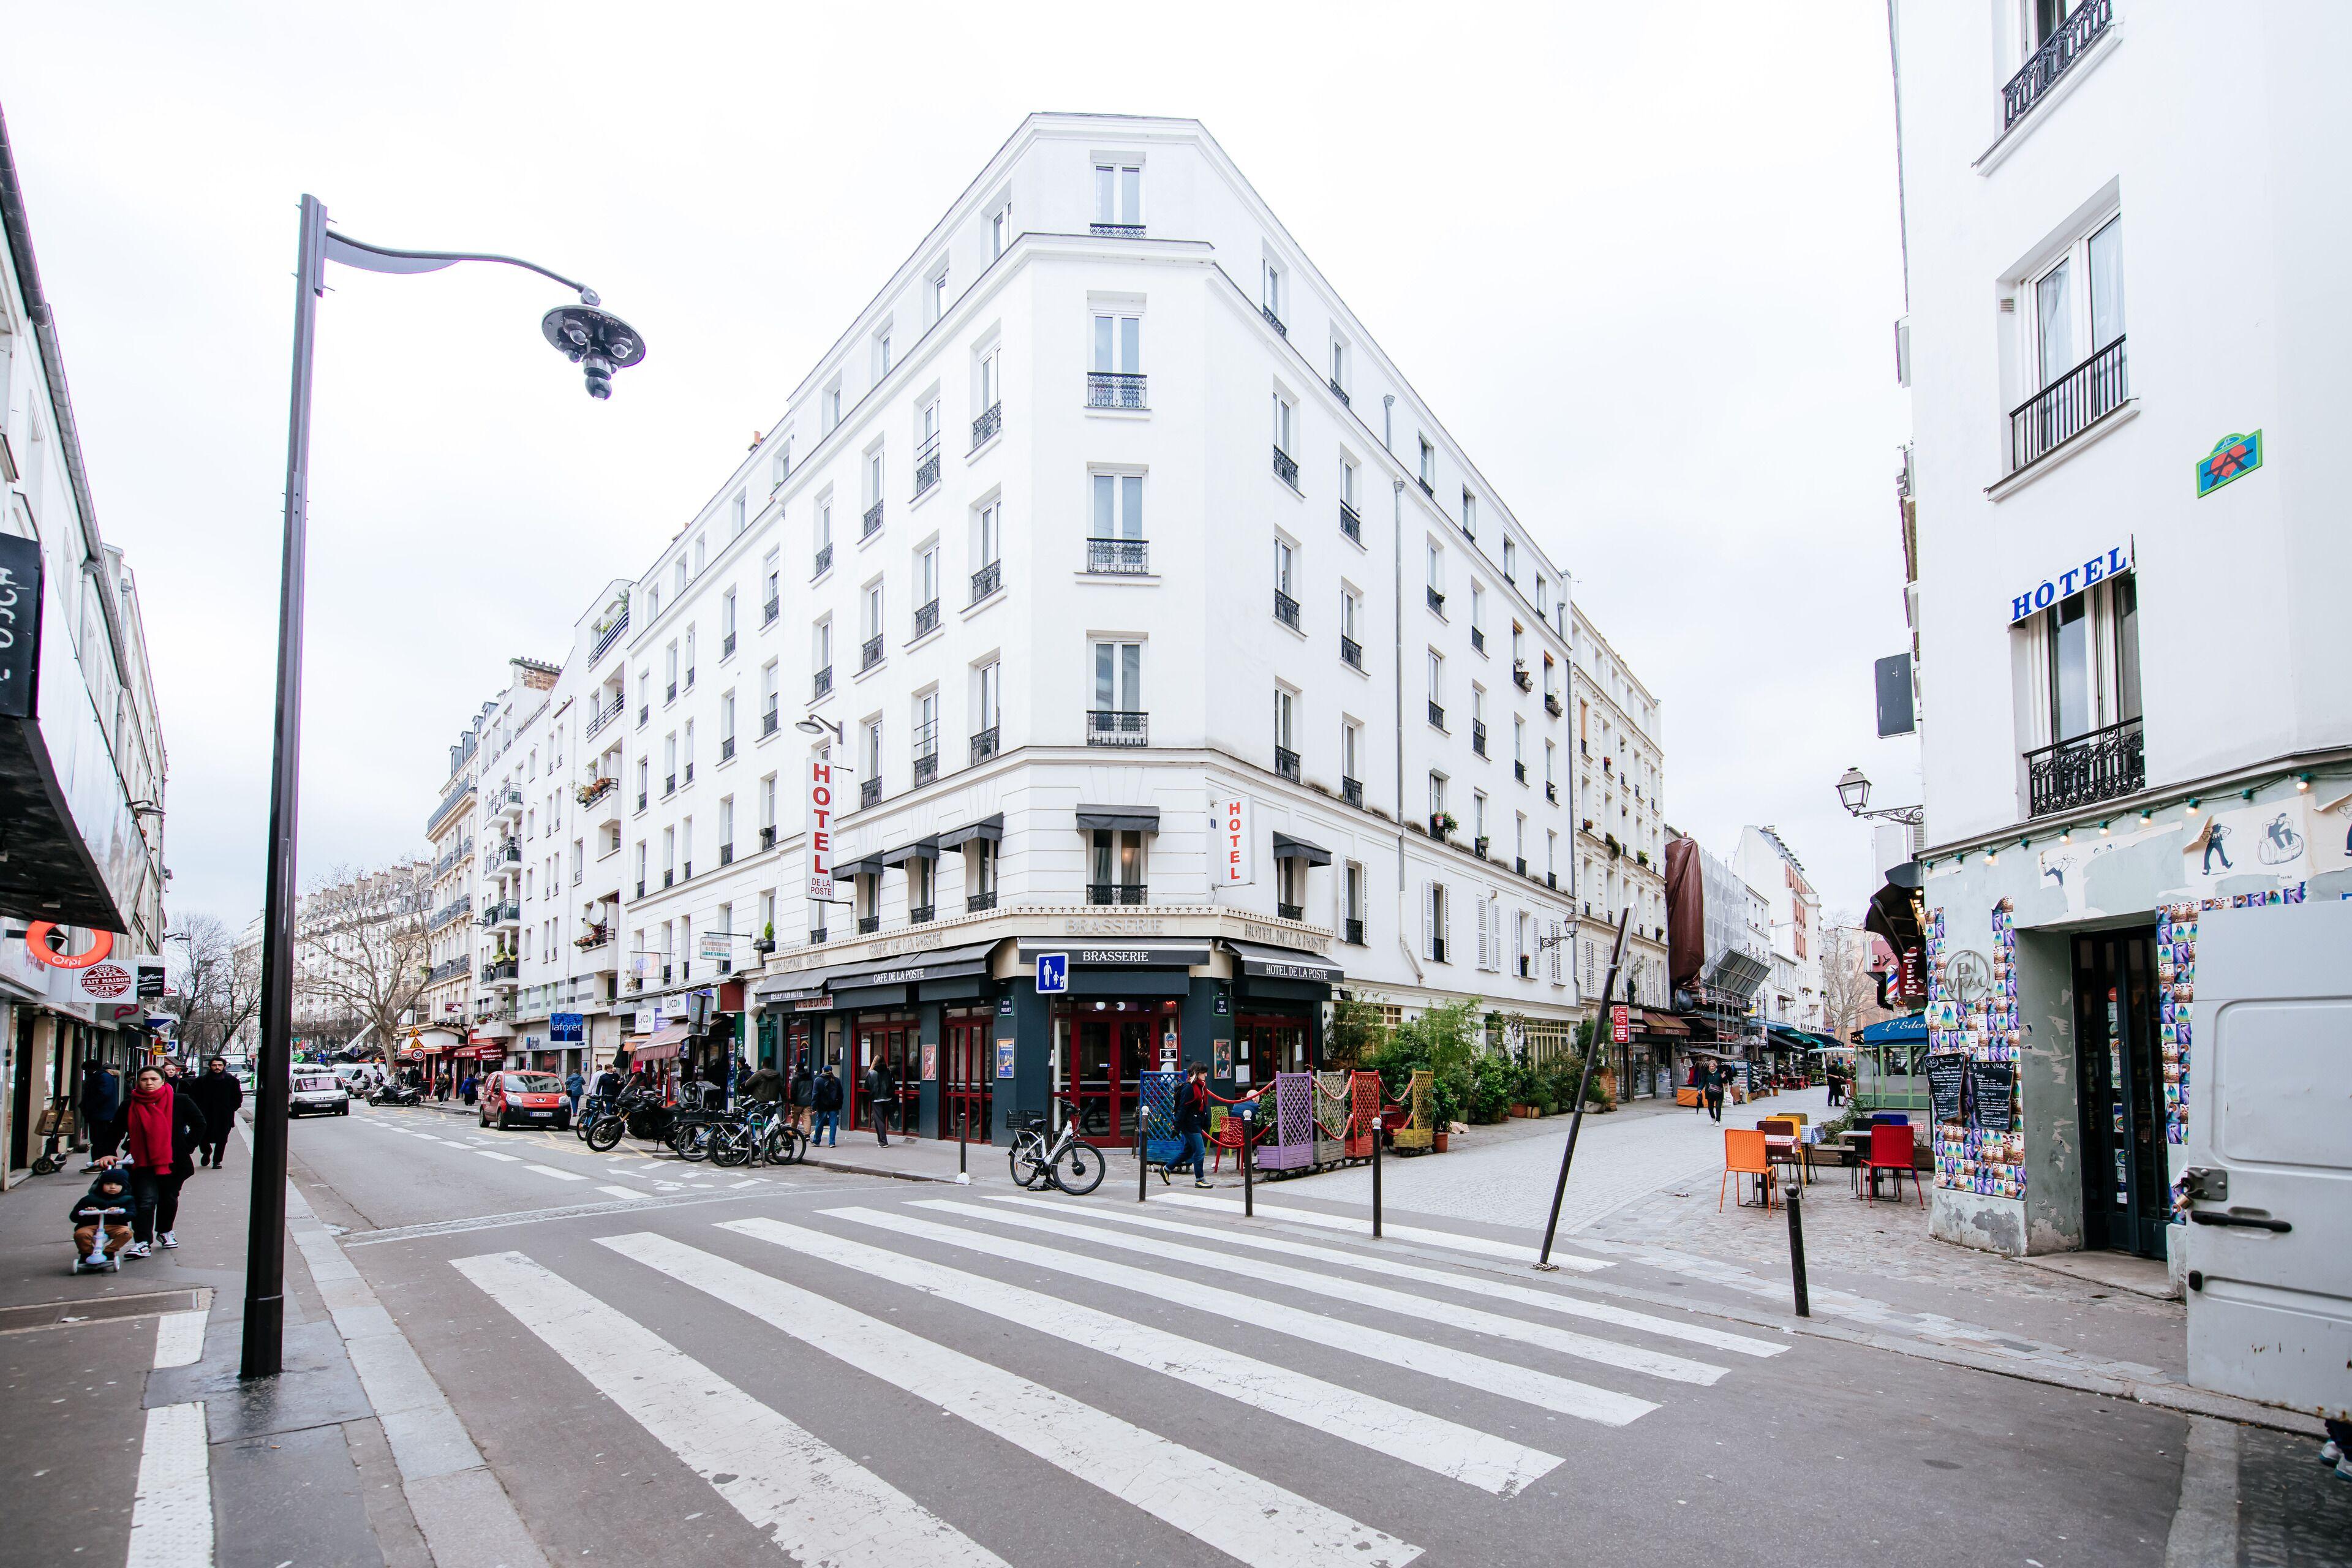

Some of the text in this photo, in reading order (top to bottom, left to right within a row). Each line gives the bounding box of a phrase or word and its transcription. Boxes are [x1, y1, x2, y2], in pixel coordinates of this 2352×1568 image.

[2012, 546, 2126, 622] HÔTEL
[813, 763, 831, 875] HOTEL
[1229, 802, 1241, 880] HOTEL
[810, 886, 832, 896] POSTE
[1065, 918, 1164, 933] BRASSERIE
[1245, 923, 1329, 951] HOTEL DE LA POSTE
[51, 956, 82, 967] Orpi
[1082, 951, 1149, 962] BRASSERIE
[873, 968, 924, 983] CAFE DE LA POSTE
[1266, 964, 1328, 979] HOTEL DE LA POSTE
[1903, 947, 1918, 995] COIFFEUR
[771, 992, 791, 1000] RECEPTION
[796, 997, 832, 1008] HOTEL DE LA POSTE
[552, 1022, 581, 1031] laforêt
